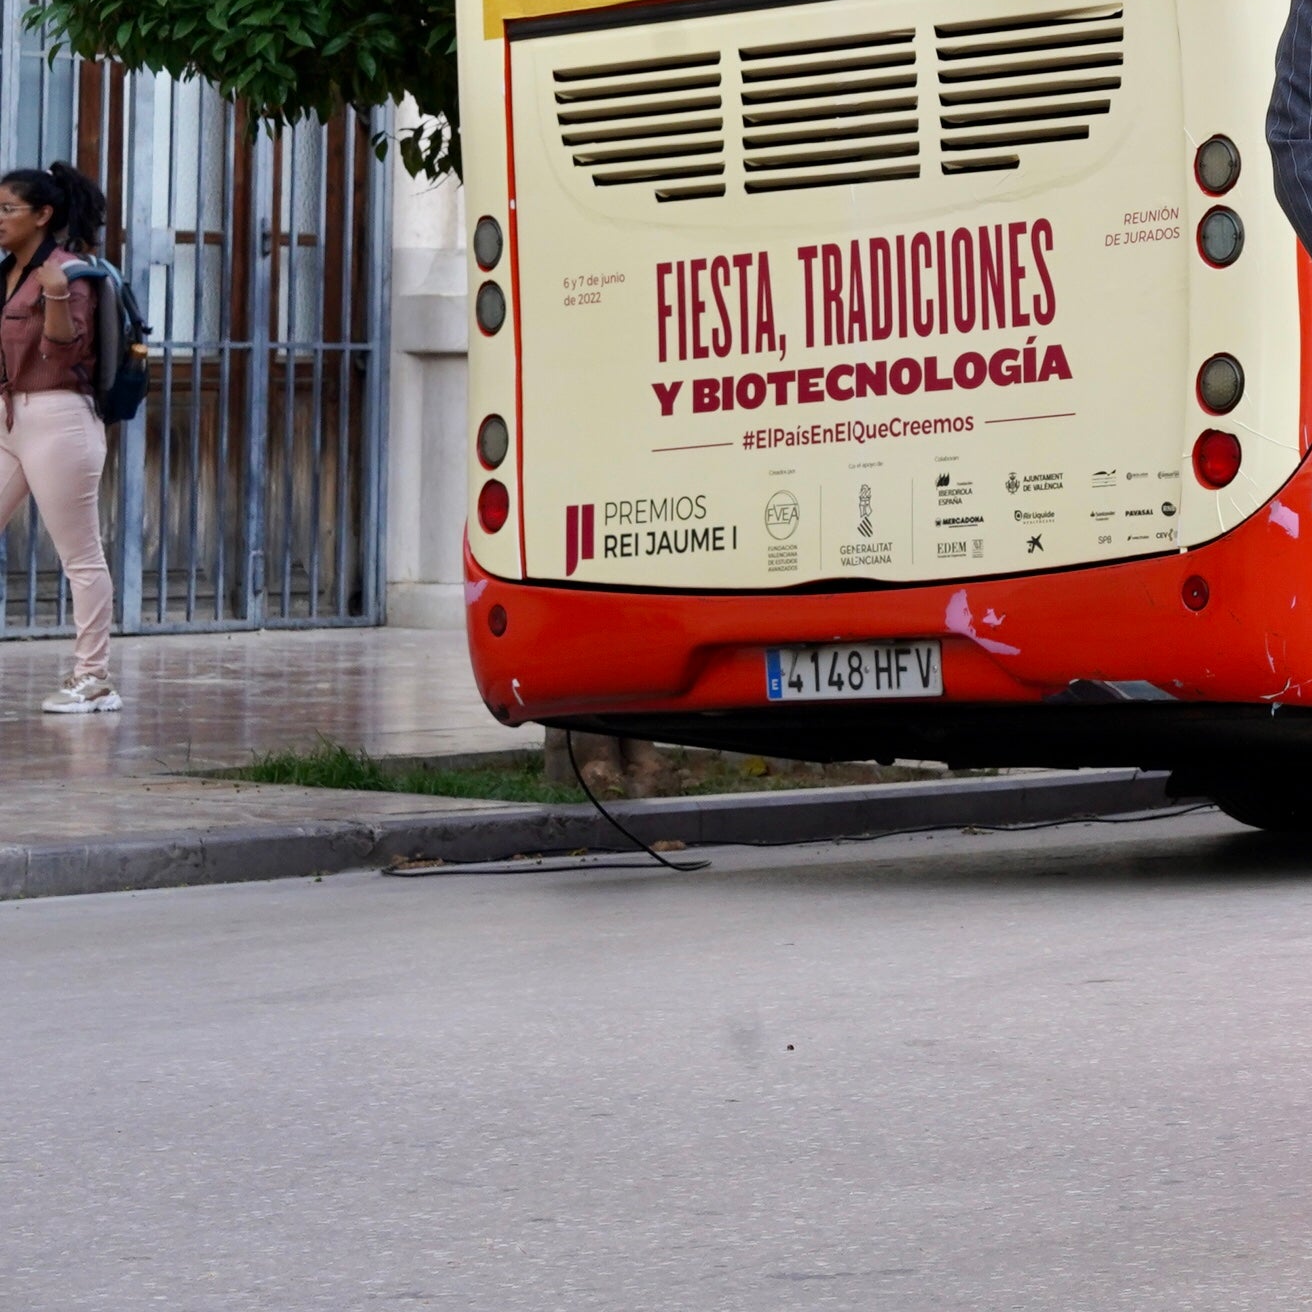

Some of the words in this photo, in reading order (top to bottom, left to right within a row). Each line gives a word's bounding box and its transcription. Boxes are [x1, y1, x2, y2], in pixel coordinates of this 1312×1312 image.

[1123, 205, 1180, 225] REUNIÓN
[1104, 233, 1121, 247] DE
[1123, 226, 1181, 245] JURADOS
[563, 277, 570, 289] 6
[571, 279, 578, 291] y
[578, 275, 585, 287] 7
[586, 274, 599, 287] de
[600, 271, 626, 288] junio
[656, 250, 788, 363] FIESTA,
[797, 217, 1057, 348] TRADICIONES
[563, 295, 577, 307] de
[577, 291, 602, 305] 2022
[651, 380, 684, 417] Y
[692, 335, 1073, 414] BIOTECNOLOGÍA
[742, 413, 975, 451] #ElPaísEnElQueCreemos
[1023, 472, 1064, 483] AJUNTAMENT
[938, 487, 973, 497] IBERDROLA
[1022, 484, 1032, 492] DE
[938, 496, 963, 506] ESPAÑA
[603, 494, 707, 526] PREMIOS
[767, 505, 800, 524] FVEA
[1125, 508, 1154, 517] PAVASAL
[942, 516, 984, 525] MERCADONA
[603, 532, 639, 559] REI
[645, 526, 725, 555] JAUME
[732, 525, 738, 550] I
[839, 542, 893, 555] GENERALITAT
[937, 541, 967, 554] EDEM
[840, 555, 892, 567] VALENCIANA
[788, 650, 864, 693] 4148
[874, 648, 932, 690] HFV
